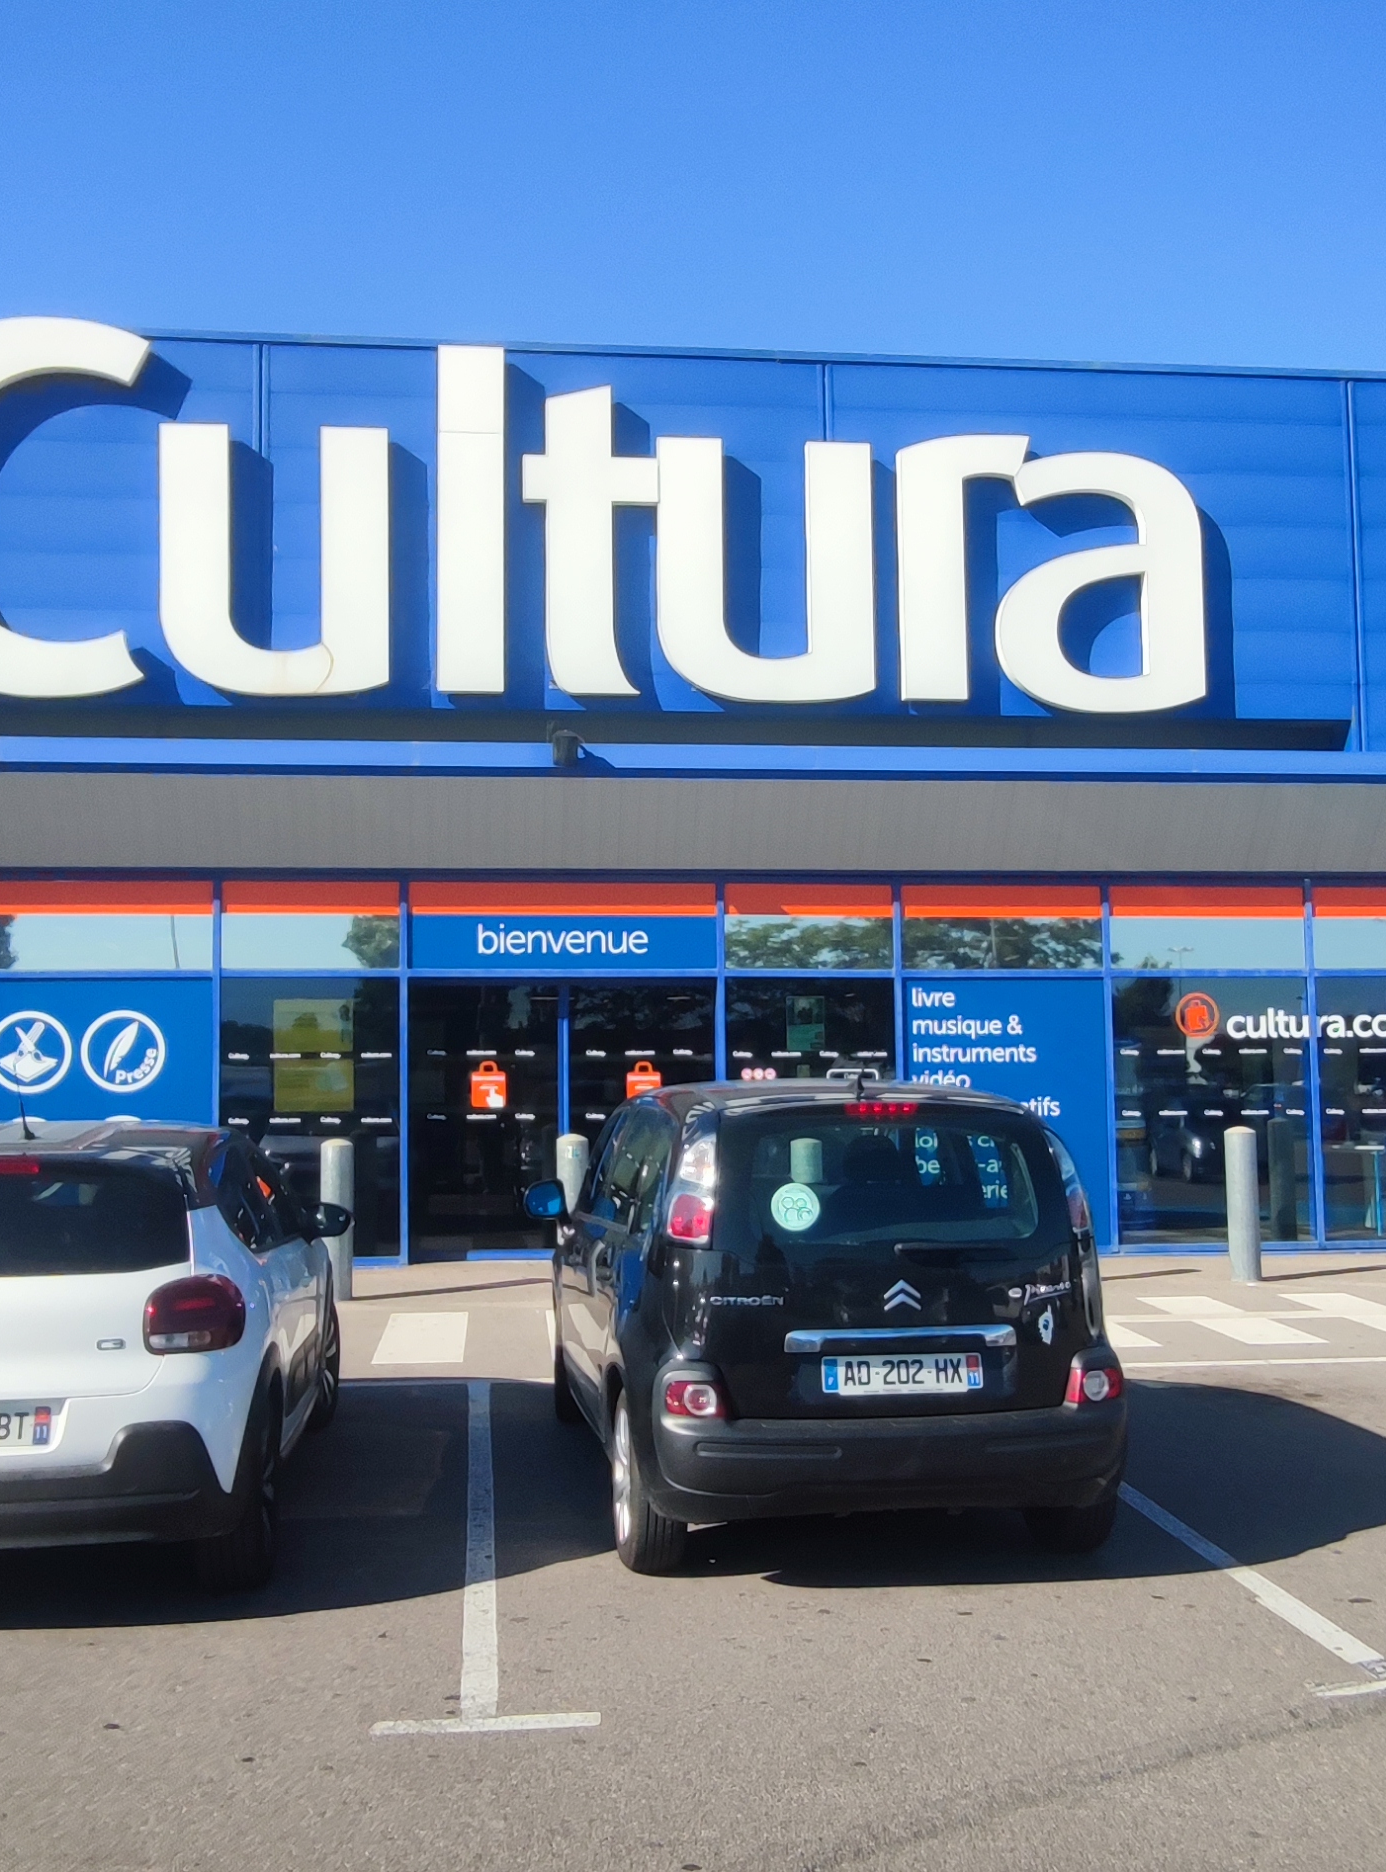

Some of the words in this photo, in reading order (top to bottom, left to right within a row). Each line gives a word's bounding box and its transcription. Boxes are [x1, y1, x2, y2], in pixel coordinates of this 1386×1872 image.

[477, 922, 649, 955] bienvenue
[911, 987, 956, 1007] livre
[912, 1015, 1002, 1040] musique
[1006, 1014, 1023, 1035] &
[912, 1042, 1038, 1063] instruments
[115, 1047, 157, 1085] Presse
[96, 1338, 126, 1351] C3
[844, 1357, 963, 1386] AD-202-HX
